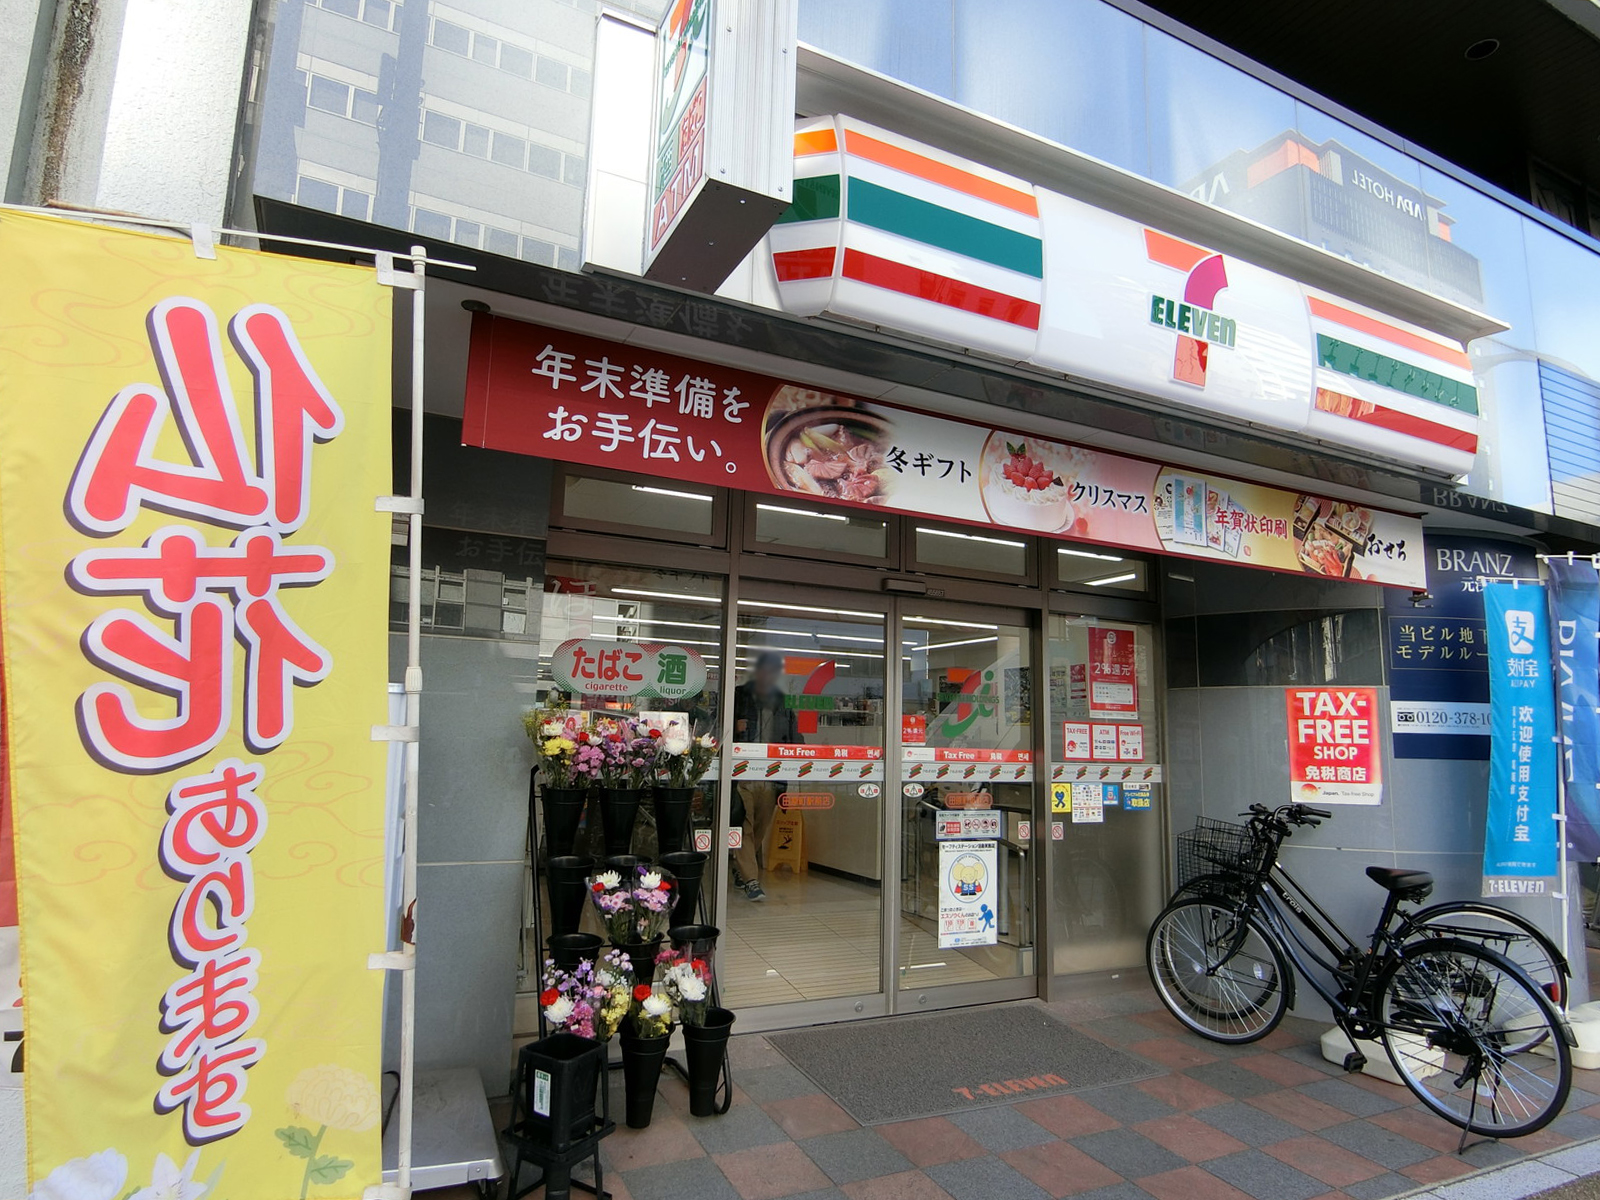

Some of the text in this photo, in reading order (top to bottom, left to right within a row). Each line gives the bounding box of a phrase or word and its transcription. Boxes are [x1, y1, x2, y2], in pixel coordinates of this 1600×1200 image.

[655, 138, 699, 239] ATM
[532, 344, 750, 424] 年末準備を
[543, 406, 738, 475] お手伝い。
[886, 446, 972, 483] 冬ギフト
[1072, 482, 1148, 514] クリスマス
[1214, 507, 1288, 539] 年賀状印刷
[1366, 533, 1407, 561] おせち
[1436, 548, 1514, 577] BRANZ
[571, 646, 688, 685] たばこ 酒
[1094, 662, 1131, 676] 2%還元
[585, 681, 687, 696] cigarette liquor
[1296, 692, 1367, 716] TAX-
[1297, 719, 1370, 744] FREE
[779, 747, 816, 757] Tax Free
[943, 750, 975, 760] Tax Free
[1313, 746, 1358, 760] SHOP
[1305, 765, 1366, 781] 免税商店
[1512, 706, 1535, 842] 欢迎使用支付宝
